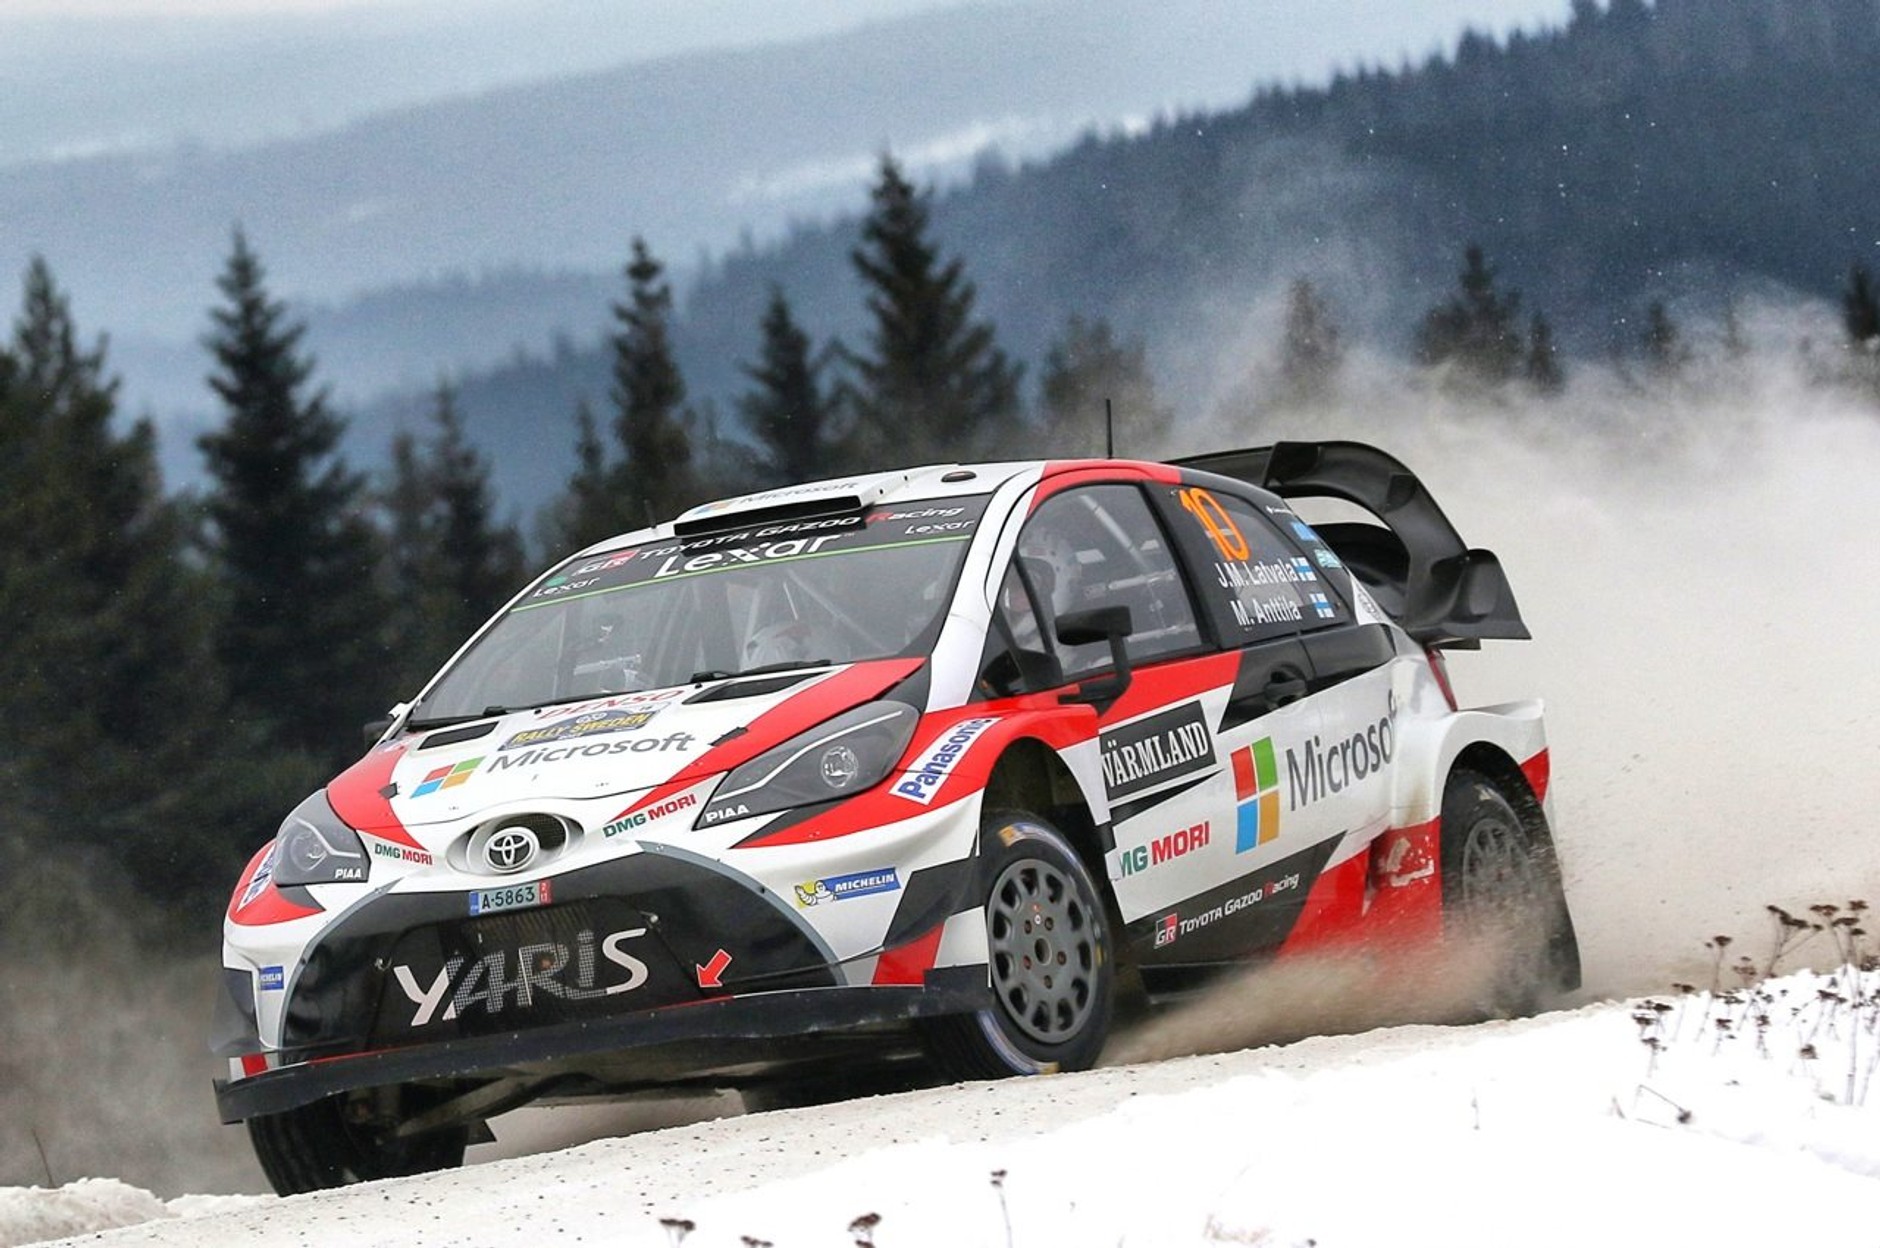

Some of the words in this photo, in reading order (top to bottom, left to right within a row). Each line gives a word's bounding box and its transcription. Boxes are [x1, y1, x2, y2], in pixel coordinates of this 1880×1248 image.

[640, 530, 750, 561] TOYOTA
[755, 516, 861, 538] GAZOO
[865, 506, 965, 524] Racing
[904, 518, 975, 536] Lexar
[1179, 488, 1250, 561] 10
[654, 534, 842, 578] Lexar
[1242, 558, 1301, 586] Latvala
[532, 577, 600, 598] Lexar
[1230, 600, 1255, 627] M.
[1252, 595, 1302, 623] Anttila
[537, 690, 685, 720] DENSO
[510, 725, 570, 745] RALLY
[569, 712, 651, 736] SWEDEN
[487, 732, 695, 773] Microsoft
[1100, 721, 1209, 788] VÄRMLAND
[602, 814, 647, 838] DMG
[647, 793, 698, 820] MORI
[705, 803, 750, 823] PIAA
[374, 843, 401, 859] DMG
[402, 849, 434, 866] MORI
[1120, 845, 1149, 878] MG
[1151, 820, 1210, 866] MORI
[334, 867, 362, 879] PIAA
[834, 872, 895, 893] MICHELIN
[482, 886, 535, 909] A-5863
[1155, 925, 1177, 946] GR
[1179, 907, 1223, 935] TOYOTA
[1224, 889, 1263, 915] GAZOO
[1263, 873, 1300, 898] Racing
